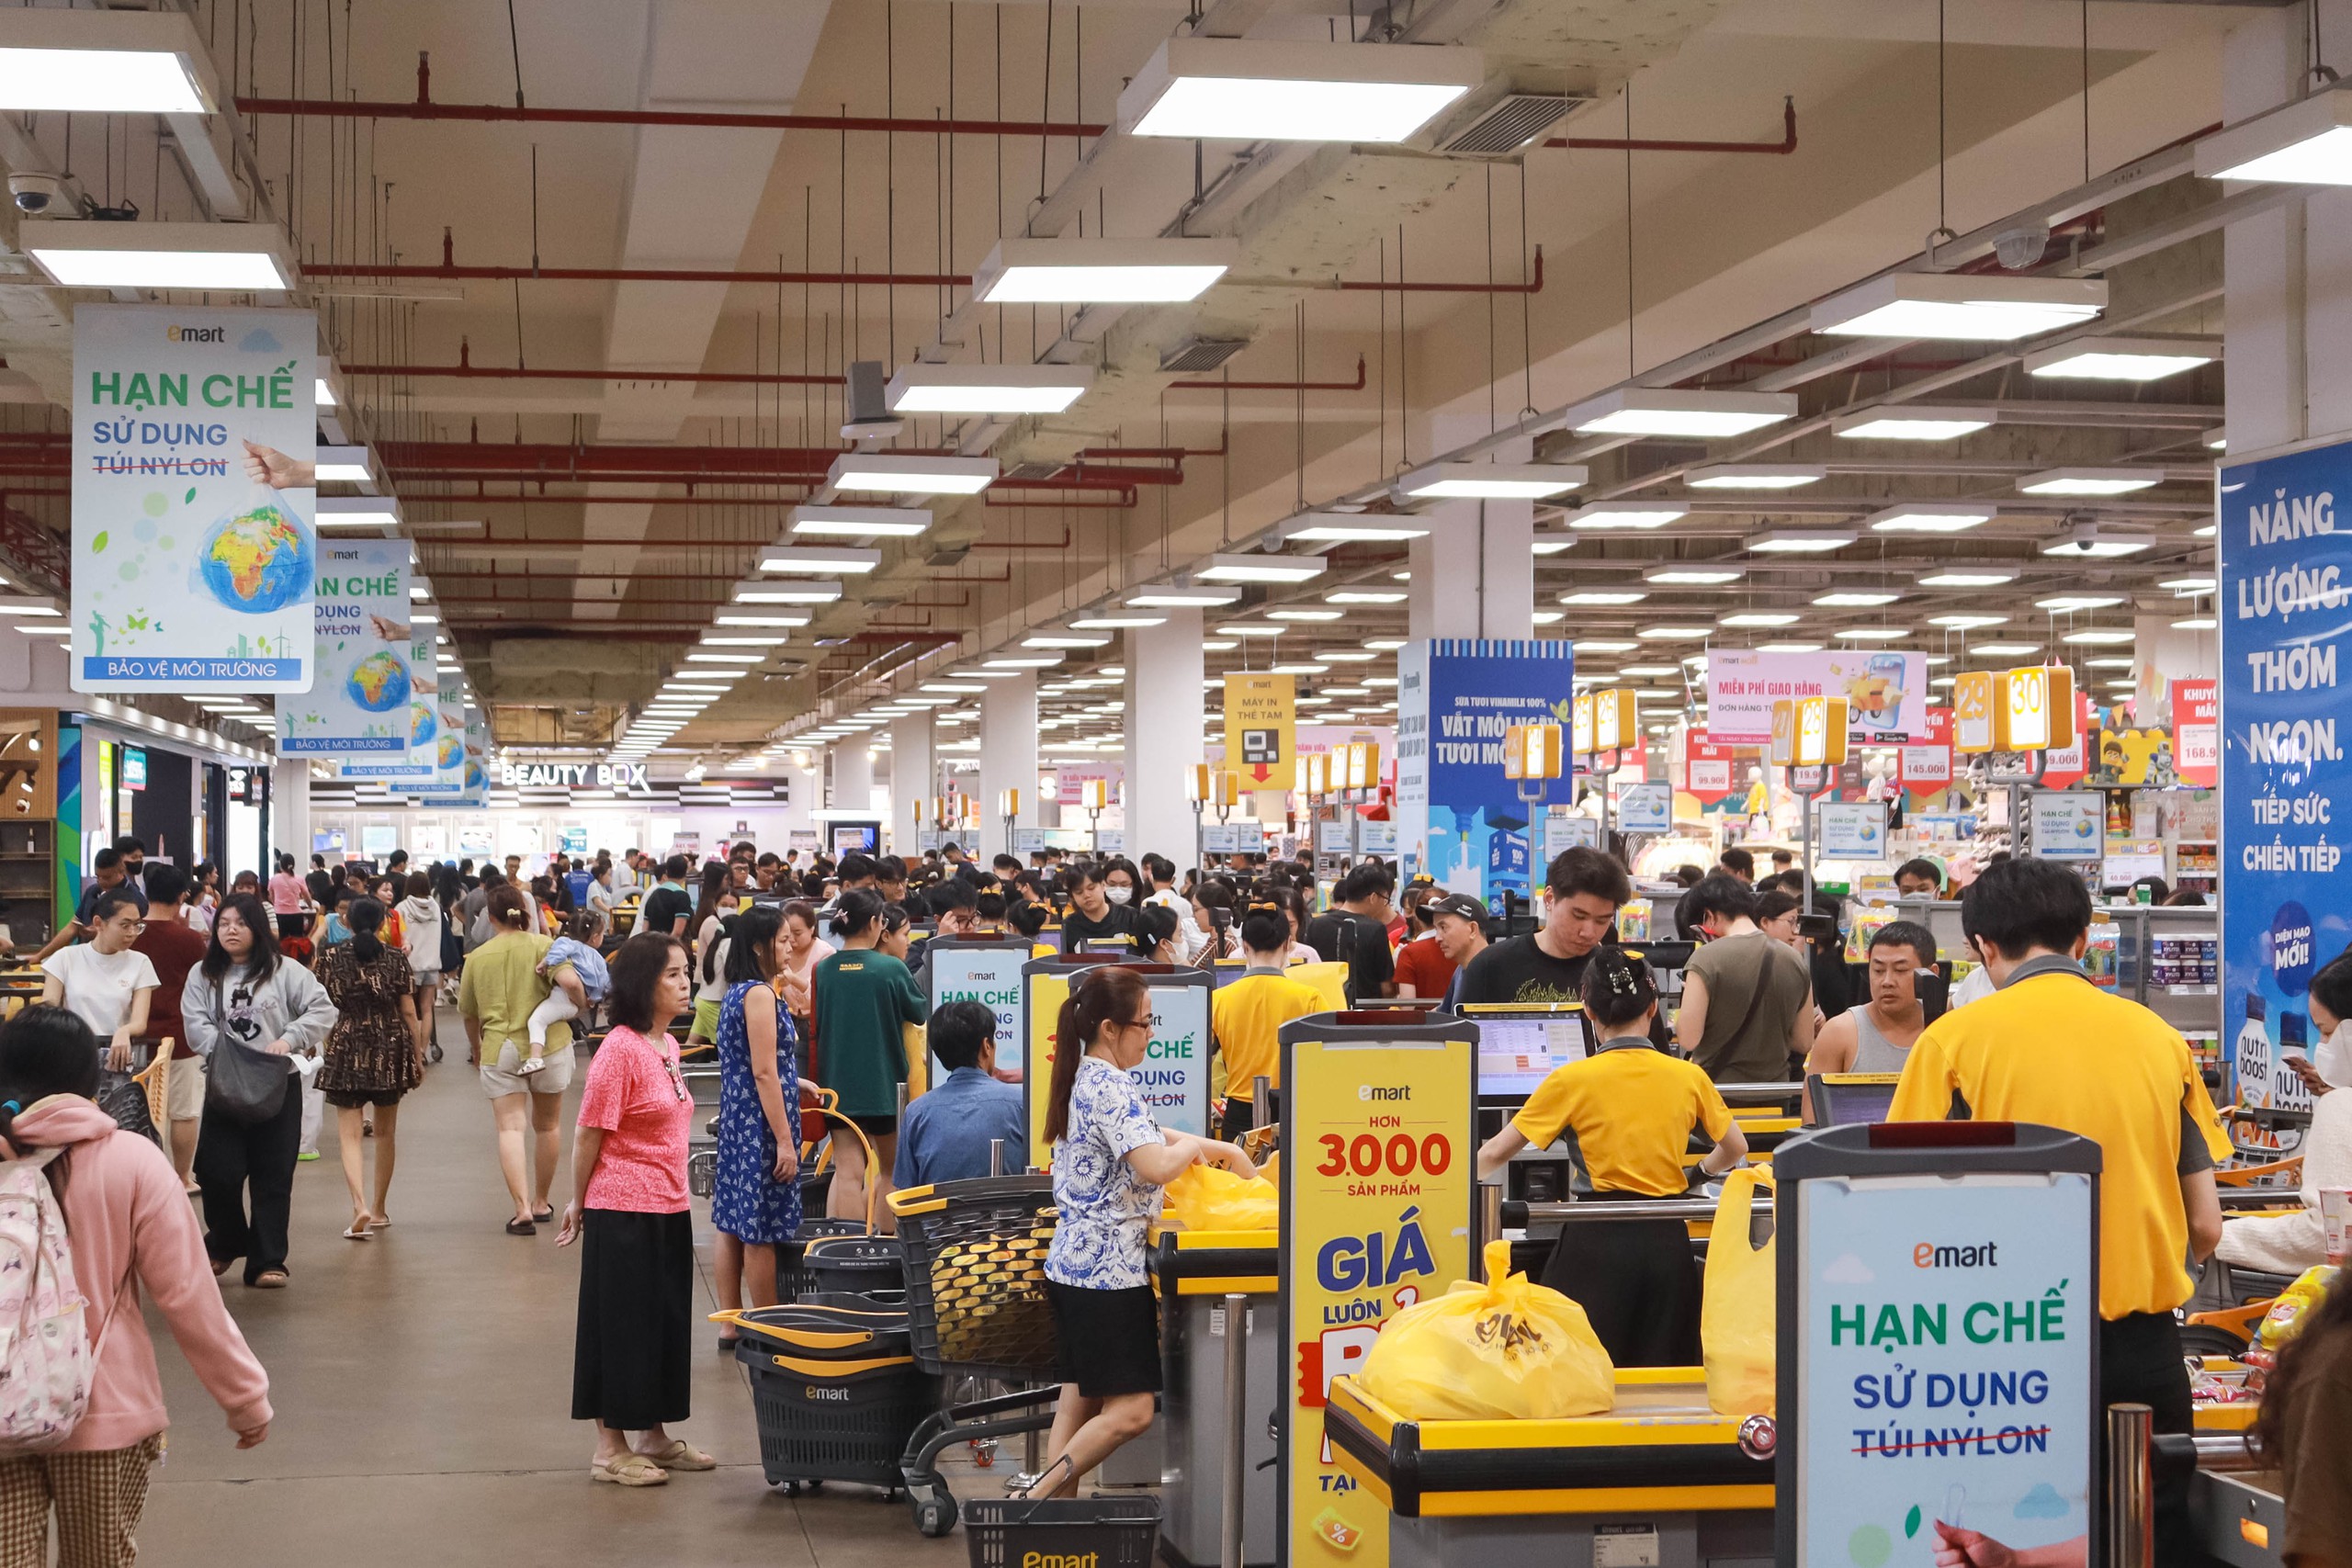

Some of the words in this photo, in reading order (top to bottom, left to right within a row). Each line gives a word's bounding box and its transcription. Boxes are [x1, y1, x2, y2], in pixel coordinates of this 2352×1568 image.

[167, 325, 225, 343] emart
[92, 371, 188, 412] HẠN
[201, 360, 298, 409] CHẾ
[93, 415, 135, 444] SỬ
[141, 423, 228, 451] DỤNG
[93, 450, 132, 475] TÚI
[141, 457, 226, 476] NYLON
[2249, 487, 2335, 547] NĂNG
[345, 569, 400, 596] CHẾ
[2238, 562, 2348, 623] LƯỢNG.
[108, 658, 144, 676] BẢO
[148, 659, 168, 679] VỆ
[173, 660, 206, 676] MÔI
[209, 660, 277, 677] TRƯỜNG
[2247, 642, 2337, 694] THƠM
[1718, 678, 1745, 694] MIỄN
[1748, 679, 1765, 695] PHÍ
[1768, 682, 1792, 695] GIAO
[1794, 681, 1822, 696] HÀNG
[1959, 678, 1988, 719] 29
[2011, 672, 2041, 715] 30
[2184, 685, 2216, 701] KHUY
[1490, 697, 1525, 708] VINAMILK
[1527, 697, 1546, 708] 100%
[1575, 700, 1589, 729] 25
[1599, 694, 1614, 724] 26
[1738, 703, 1762, 712] HÀNG
[1442, 710, 1475, 737] VẮT
[1804, 702, 1823, 735] 28
[1926, 712, 1944, 726] YẾN
[296, 739, 316, 750] BẢO
[332, 739, 352, 749] MÔI
[353, 739, 390, 750] TRƯỜNG
[1435, 742, 1479, 764] TƯƠI
[1482, 739, 1506, 764] MỖ
[1702, 746, 1717, 756] MÃI
[2186, 747, 2216, 758] 168.9
[2249, 717, 2344, 764] NGON.
[501, 764, 588, 785] BEAUTY
[596, 764, 652, 795] BOX
[1699, 775, 1725, 784] 99.900
[1907, 764, 1945, 774] 145.000
[2251, 786, 2290, 825] TIẾP
[2293, 792, 2331, 825] SỨC
[2243, 833, 2298, 872] CHIẾN
[2299, 833, 2340, 873] TIẾP
[2275, 929, 2292, 944] DIỆN
[2292, 926, 2311, 940] MẠO
[2275, 940, 2310, 971] MỚI!
[967, 971, 996, 981] emart
[984, 984, 1021, 1005] CHẾ
[995, 1013, 1013, 1024] NG
[2242, 1035, 2267, 1059] nutri
[2240, 1056, 2267, 1081] boost
[1142, 1093, 1185, 1107] YLON
[1358, 1084, 1411, 1101] emart
[1369, 1114, 1401, 1128] HƠN
[1316, 1133, 1452, 1177] 3.000
[1347, 1182, 1376, 1196] SẢN
[1380, 1179, 1420, 1196] PHẨM
[1317, 1205, 1436, 1293] GIÁ
[1914, 1242, 1997, 1269] emart
[1323, 1297, 1382, 1325] LUÔN
[1831, 1303, 1947, 1354] HẠN
[1962, 1278, 2069, 1345] CHẾ
[806, 1385, 849, 1401] emart
[1853, 1362, 1917, 1409] SỬ
[1927, 1370, 2049, 1418] DỤNG
[1852, 1419, 1913, 1459] TÚI
[1925, 1424, 2047, 1458] NYLON
[1023, 1551, 1099, 1568] emart
